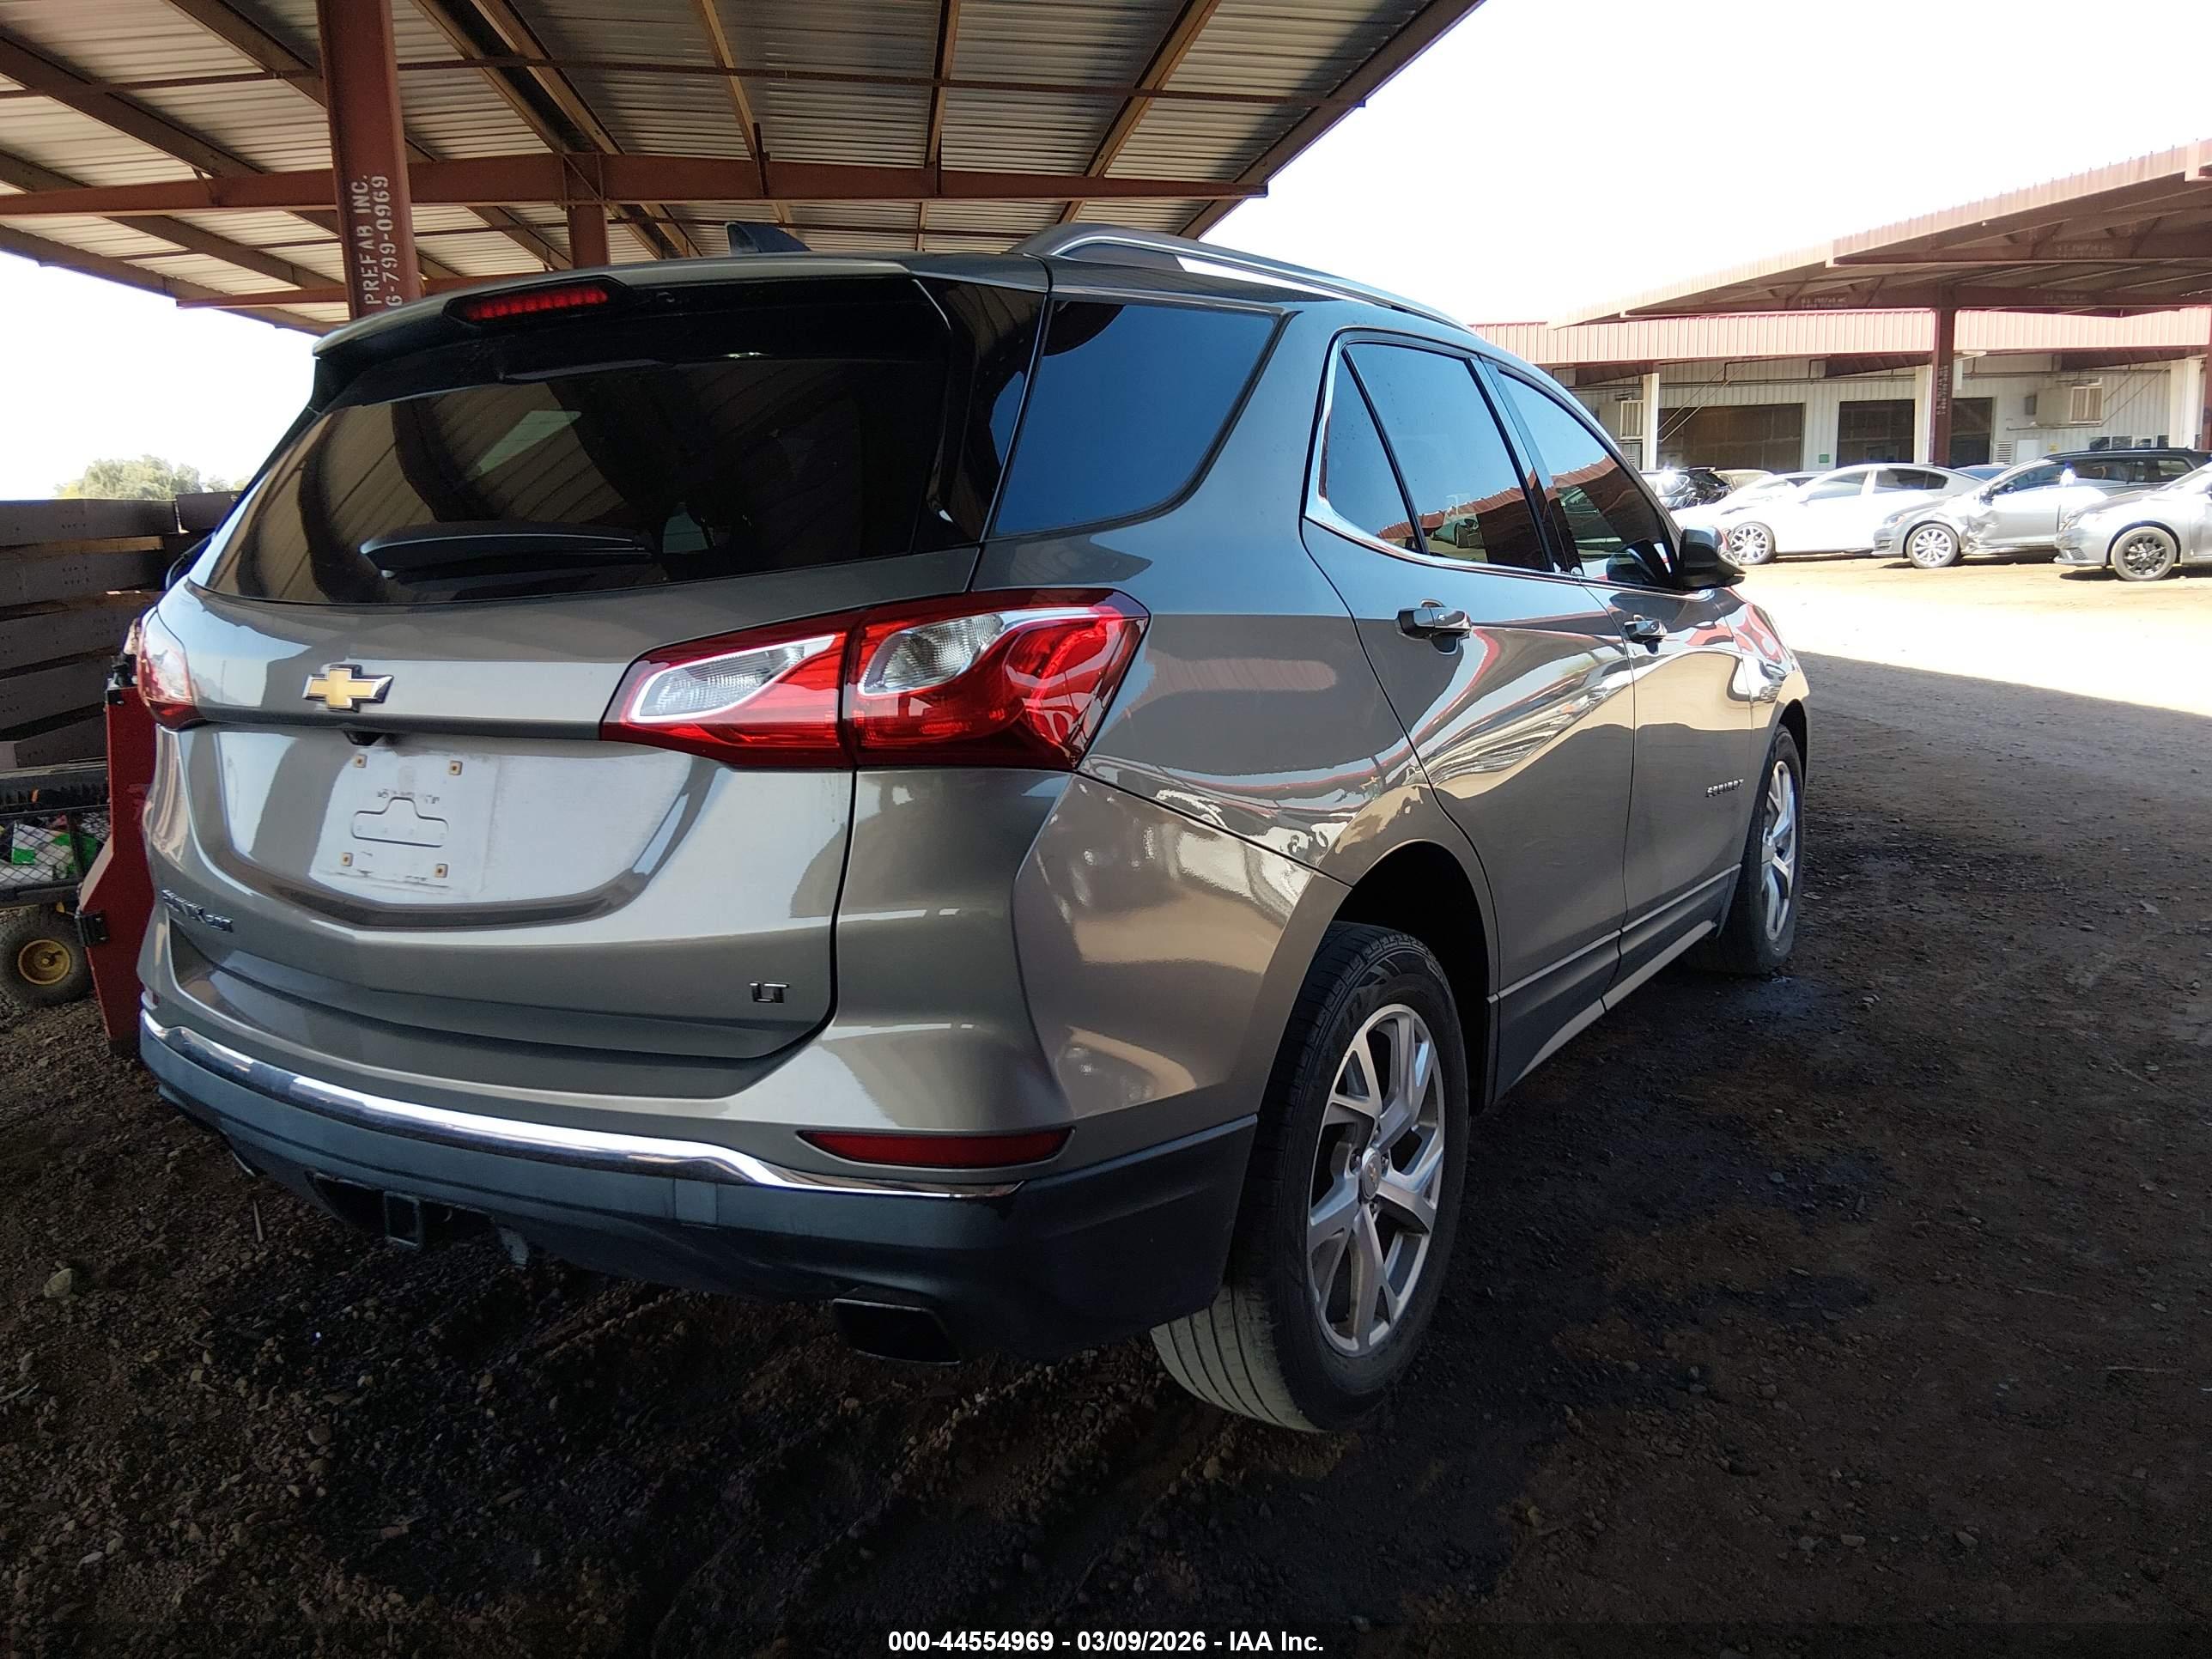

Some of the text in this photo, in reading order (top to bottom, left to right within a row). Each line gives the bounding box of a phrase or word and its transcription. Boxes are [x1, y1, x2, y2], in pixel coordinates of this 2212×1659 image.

[350, 174, 383, 306] PREFAB INC.
[749, 981, 789, 1004] LT
